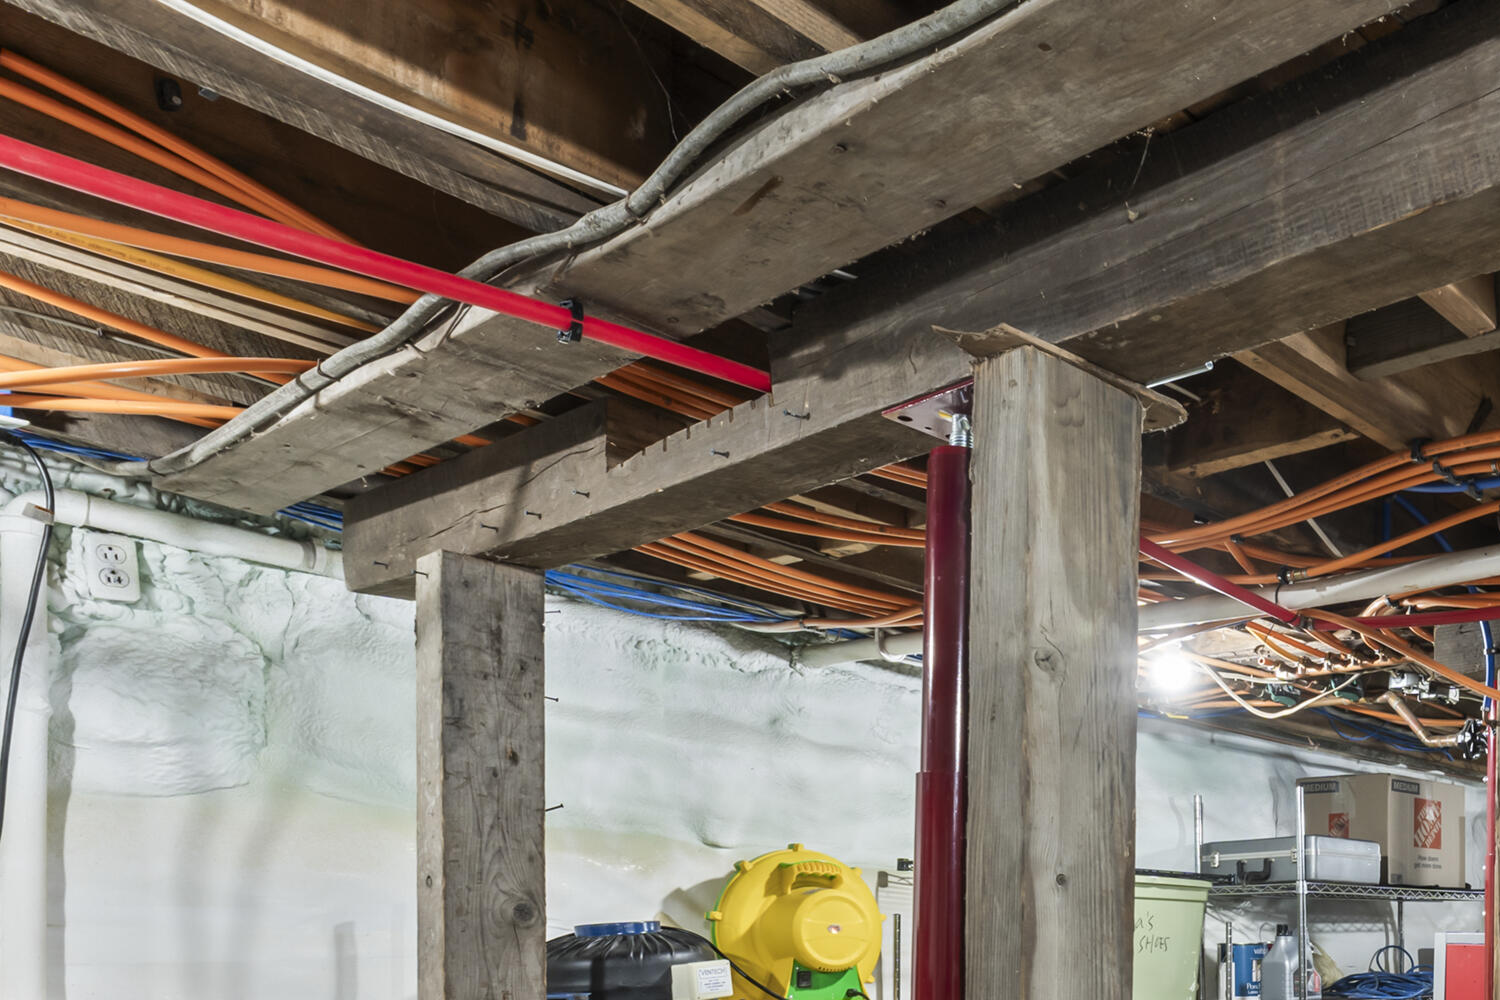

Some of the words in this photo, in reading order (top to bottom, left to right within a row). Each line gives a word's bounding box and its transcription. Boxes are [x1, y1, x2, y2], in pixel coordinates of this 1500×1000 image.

[1304, 782, 1337, 792] MEDIUM
[1393, 781, 1418, 792] MEDIUM
[1138, 936, 1170, 953] SHOES
